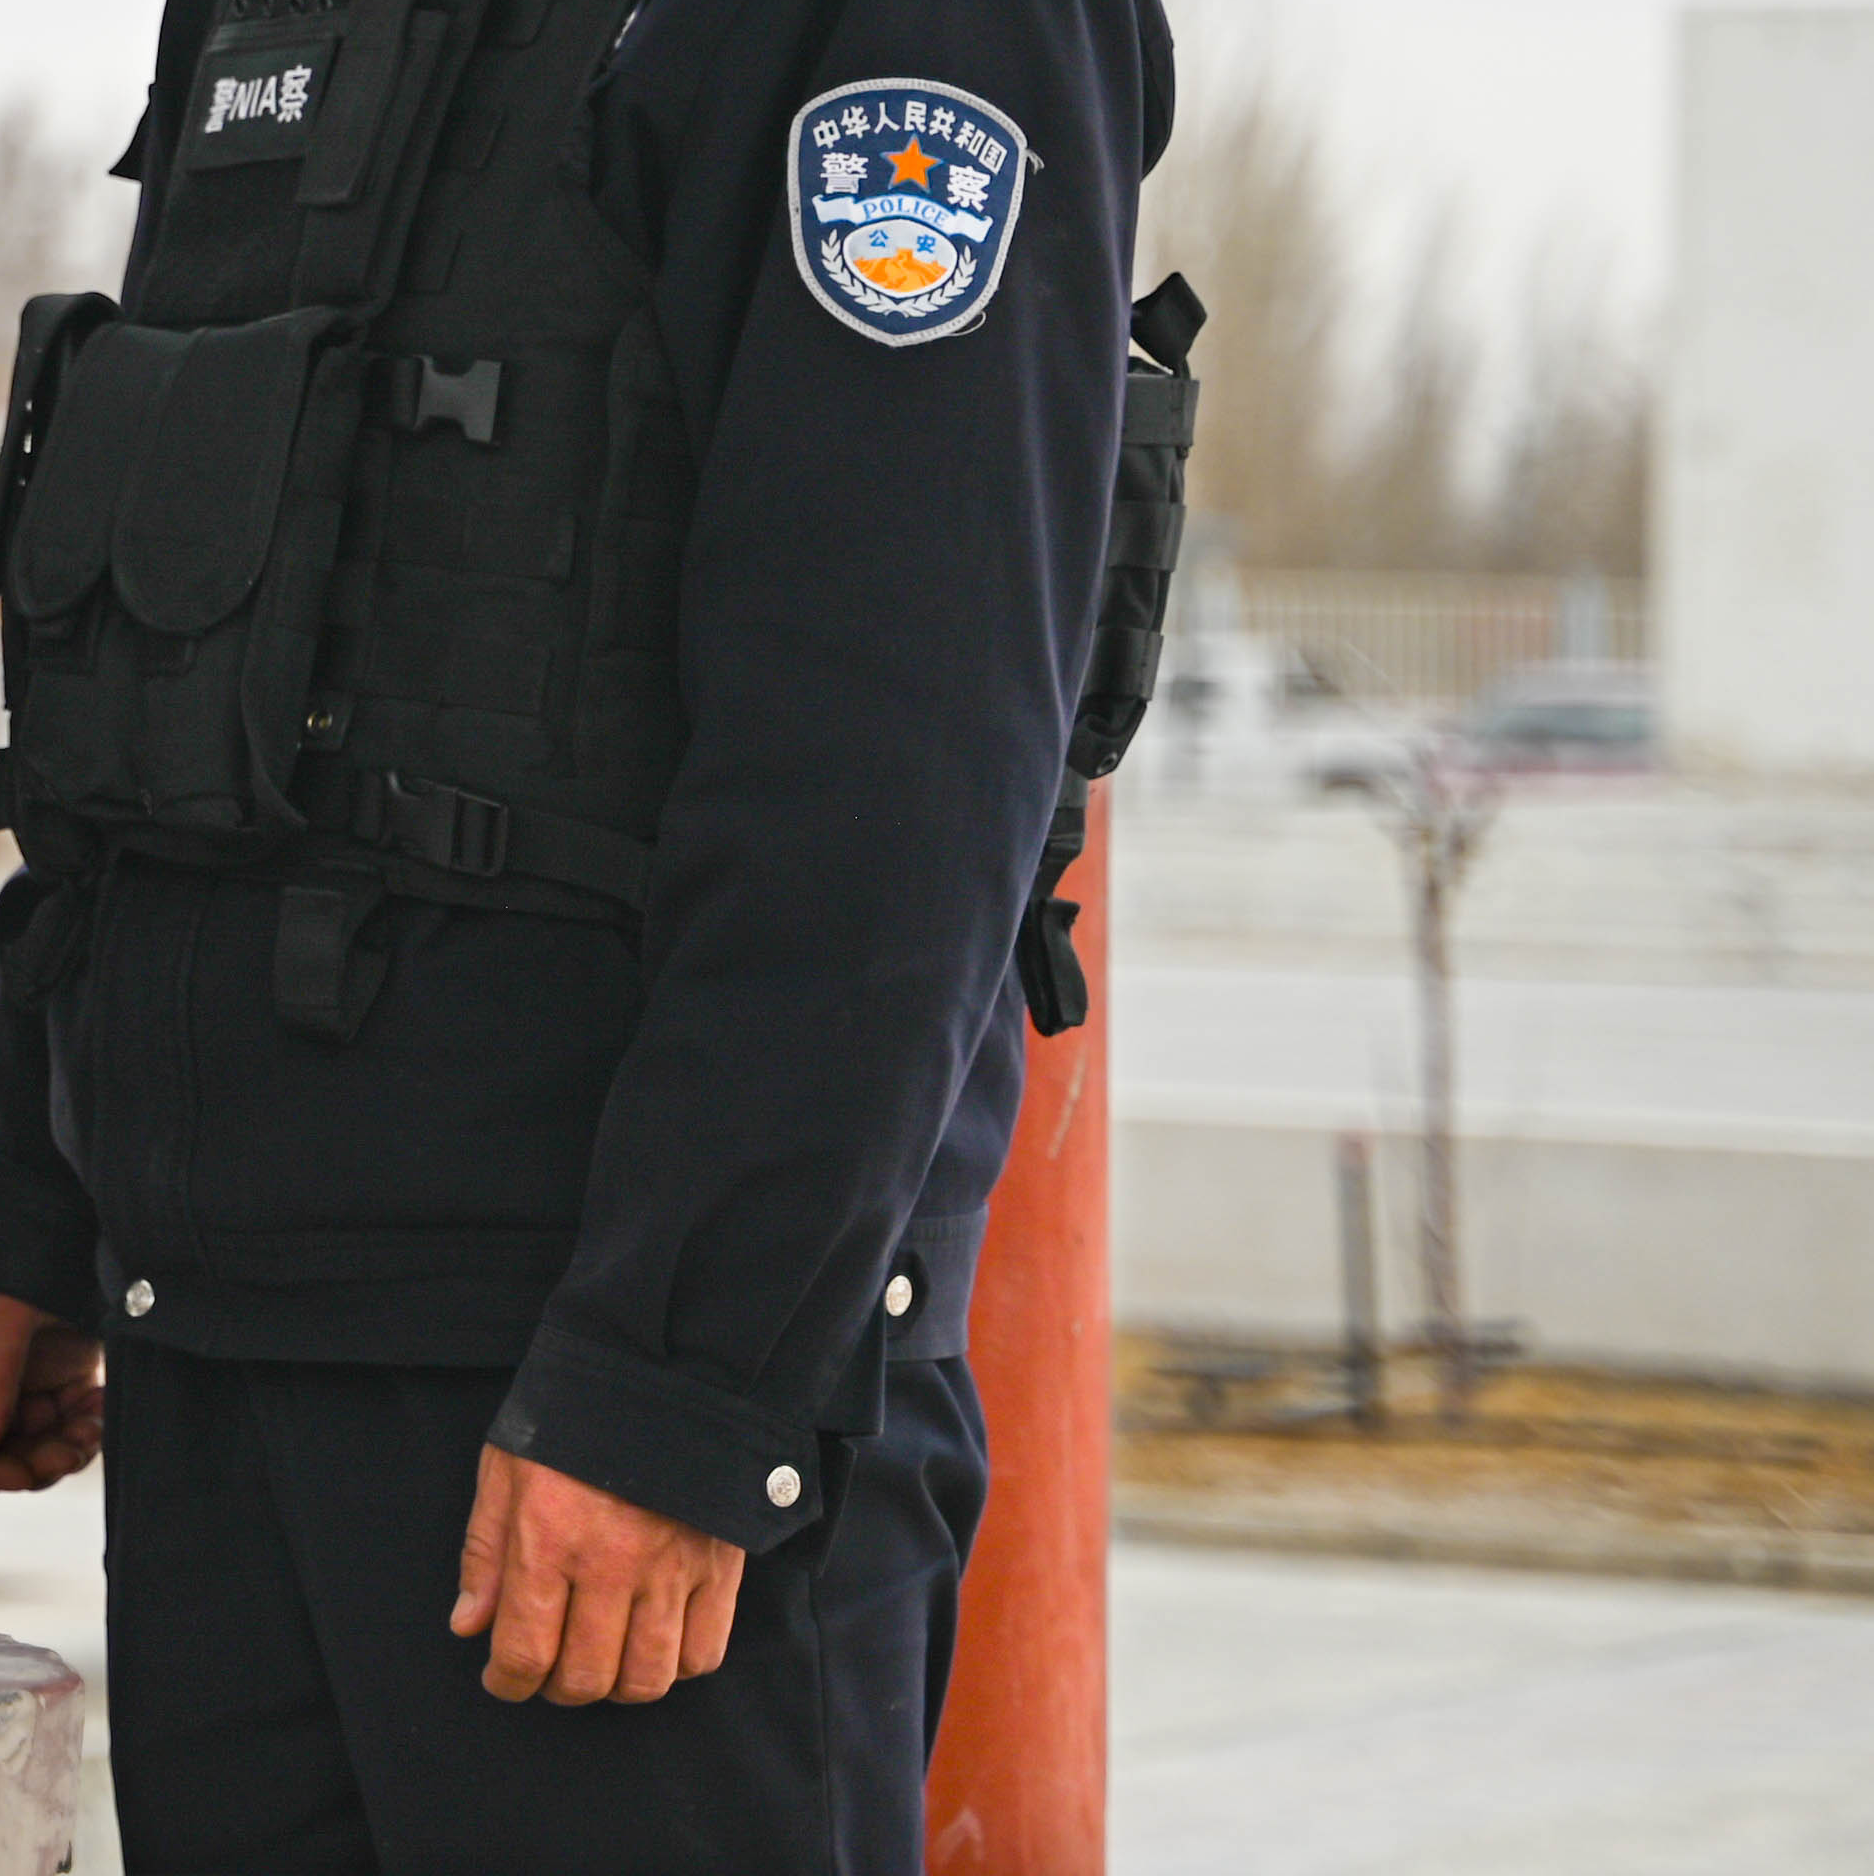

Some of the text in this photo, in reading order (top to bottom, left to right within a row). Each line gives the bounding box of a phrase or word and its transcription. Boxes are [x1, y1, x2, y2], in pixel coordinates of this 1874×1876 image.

[813, 101, 1008, 175] 中华人民共和国
[862, 195, 948, 225] POLICE
